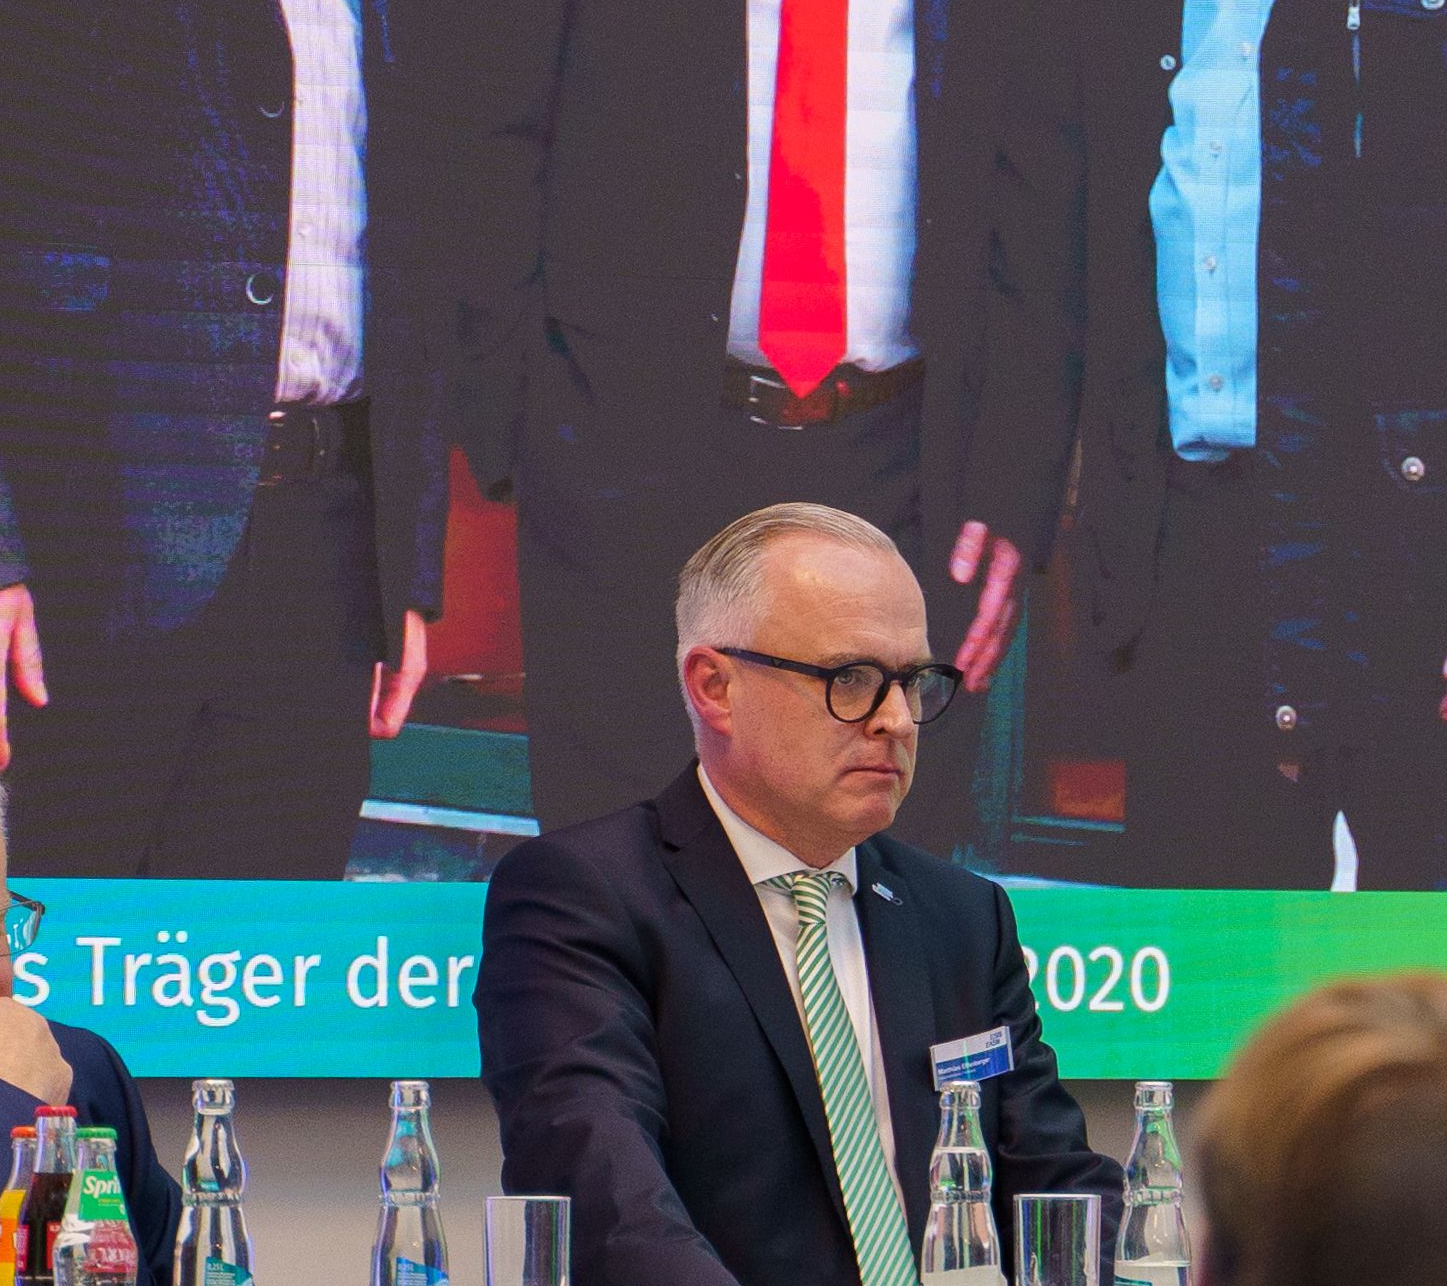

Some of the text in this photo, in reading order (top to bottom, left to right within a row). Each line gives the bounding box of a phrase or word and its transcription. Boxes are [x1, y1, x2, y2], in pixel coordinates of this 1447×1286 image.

[75, 930, 321, 1027] Träger
[346, 935, 475, 1009] der
[83, 1175, 121, 1198] Spri
